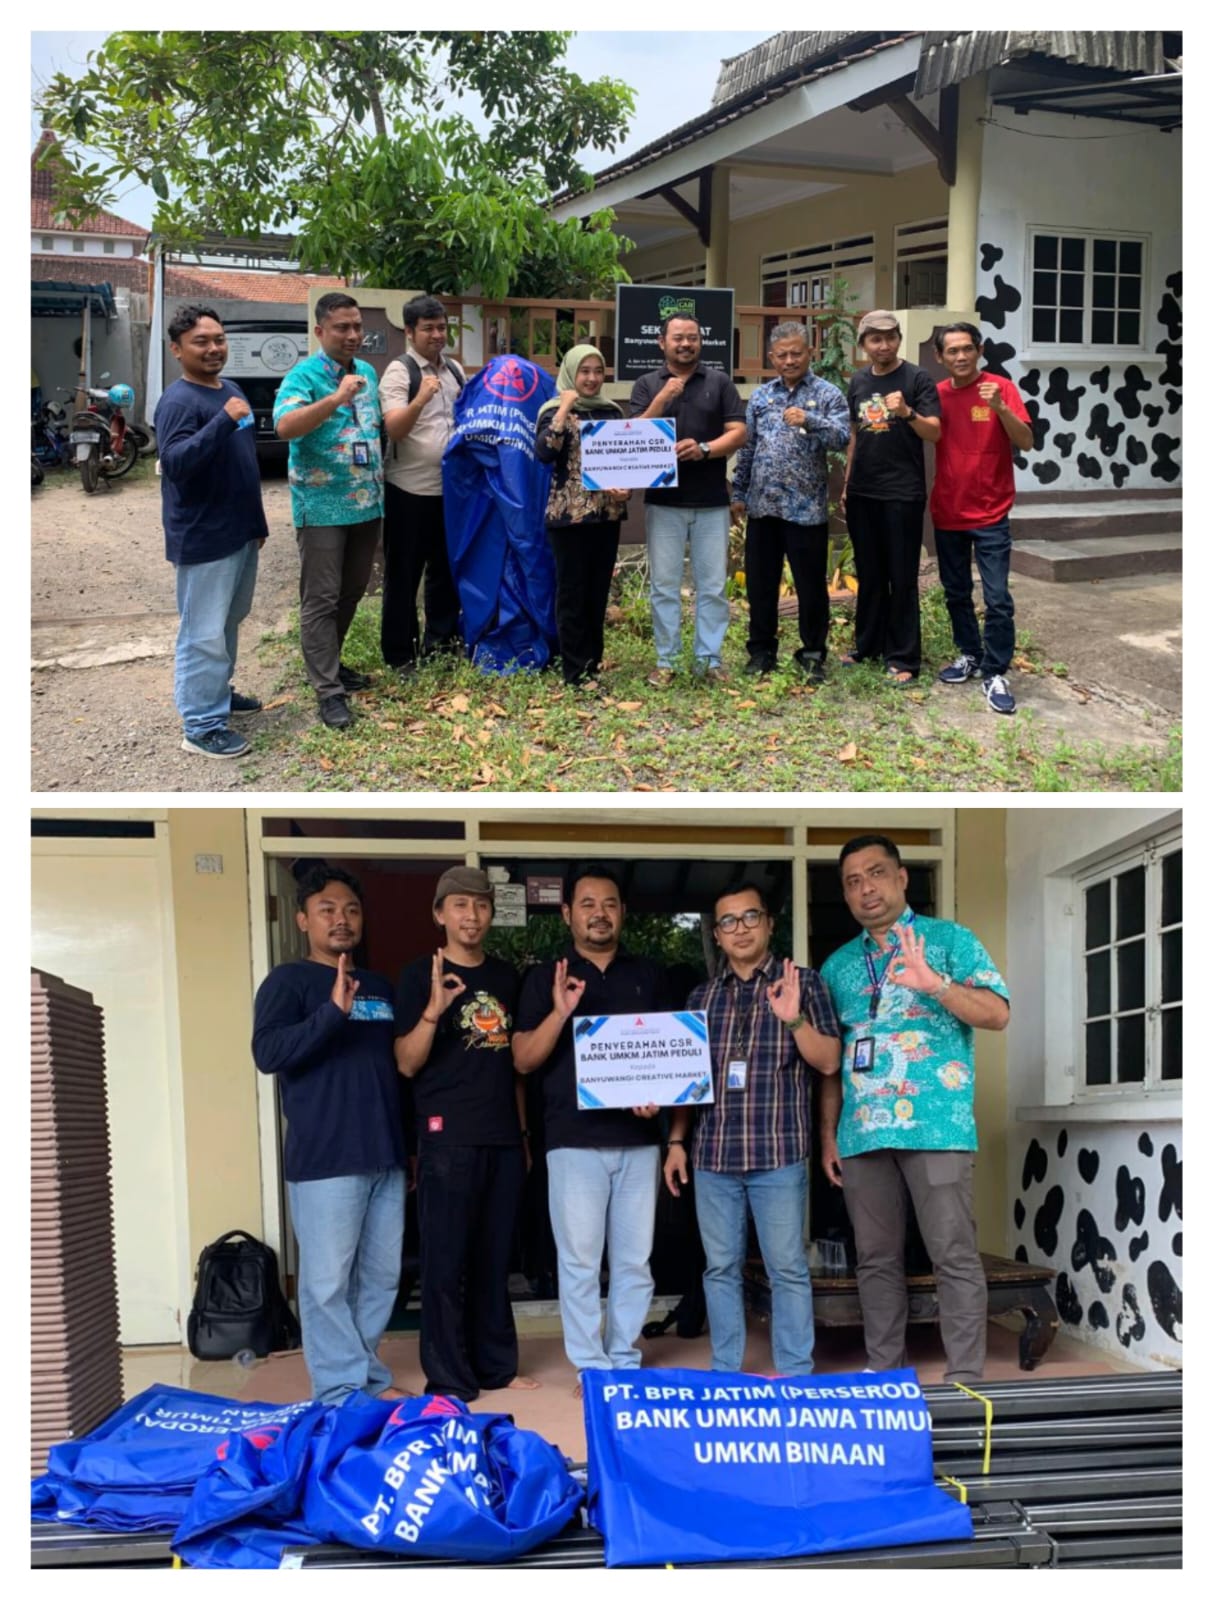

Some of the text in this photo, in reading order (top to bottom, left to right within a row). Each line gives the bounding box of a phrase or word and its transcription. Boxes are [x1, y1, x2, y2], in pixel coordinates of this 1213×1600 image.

[702, 339, 727, 347] Market
[580, 1047, 702, 1062] BANK UMKM JATIM PEDULI
[590, 1038, 693, 1052] PENYERAHAN CSR
[580, 1071, 707, 1084] BANYUWANGI CREATIVE MARKET
[603, 1381, 922, 1402] PT. BPR JATIM (PERSEROD
[616, 1408, 691, 1431] BANK
[696, 1407, 781, 1429] UMKM
[786, 1407, 857, 1430] JAWA
[694, 1441, 886, 1466] UMKM BINAAN
[360, 1494, 395, 1535] PT.
[383, 1439, 432, 1491] BPR
[394, 1457, 451, 1543] BANK
